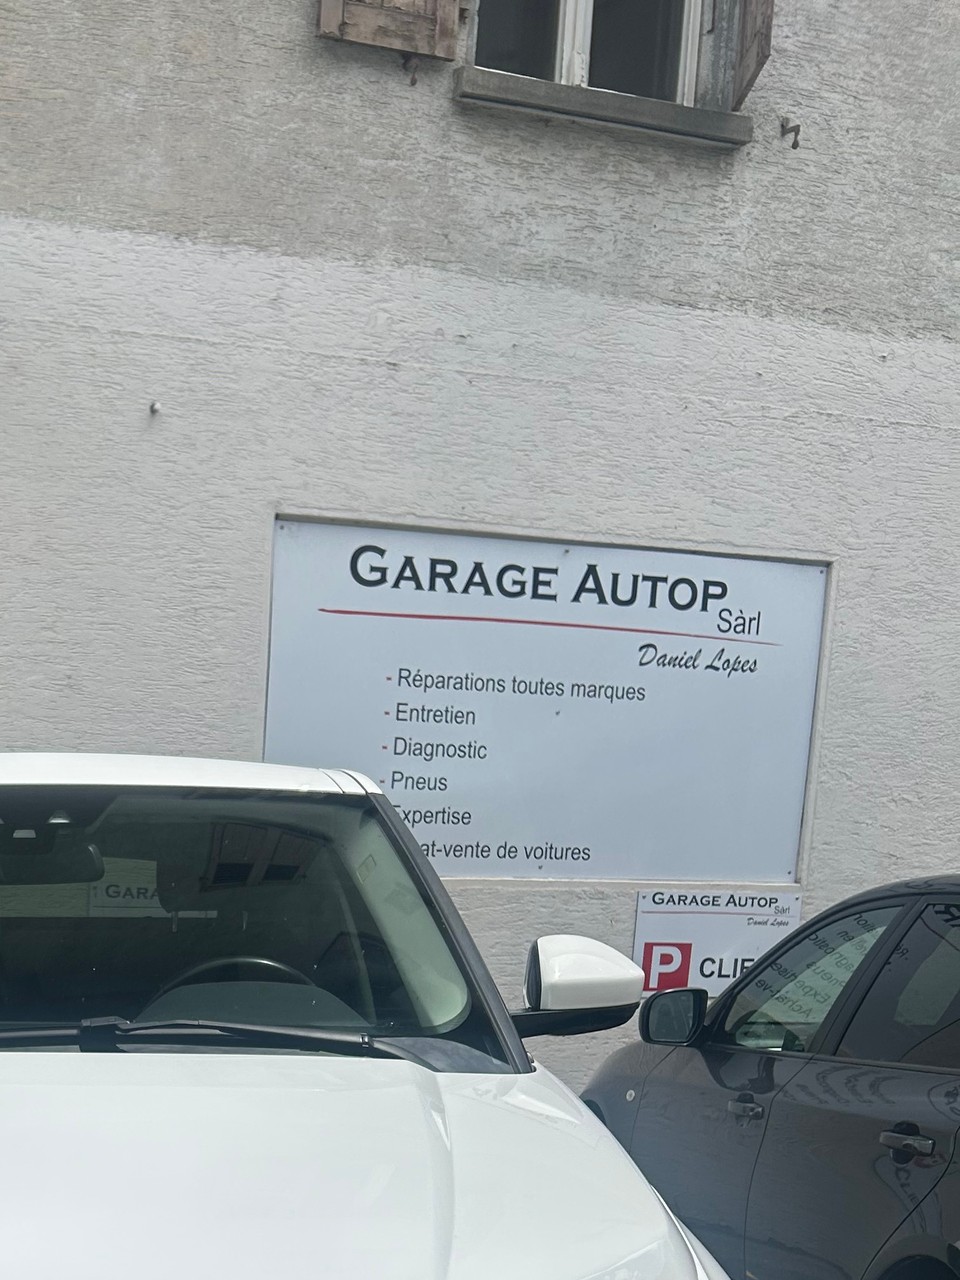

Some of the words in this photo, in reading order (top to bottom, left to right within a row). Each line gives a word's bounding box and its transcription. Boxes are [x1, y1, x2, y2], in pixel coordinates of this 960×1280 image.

[349, 544, 559, 602] GARAGE
[570, 563, 728, 612] AUTOP
[717, 608, 761, 636] Sàrl
[638, 643, 702, 670] Daniel
[705, 647, 759, 678] Lopes
[397, 667, 506, 694] Réparations
[511, 675, 565, 697] toutes
[570, 683, 646, 704] marques
[395, 702, 476, 725] Entretien
[392, 736, 488, 761] Diagnostic
[390, 770, 448, 792] Pneus
[496, 841, 518, 859] de
[524, 841, 591, 861] voitures
[652, 892, 721, 906] GARAGE
[726, 894, 778, 908] AUTOP
[649, 945, 682, 989] P
